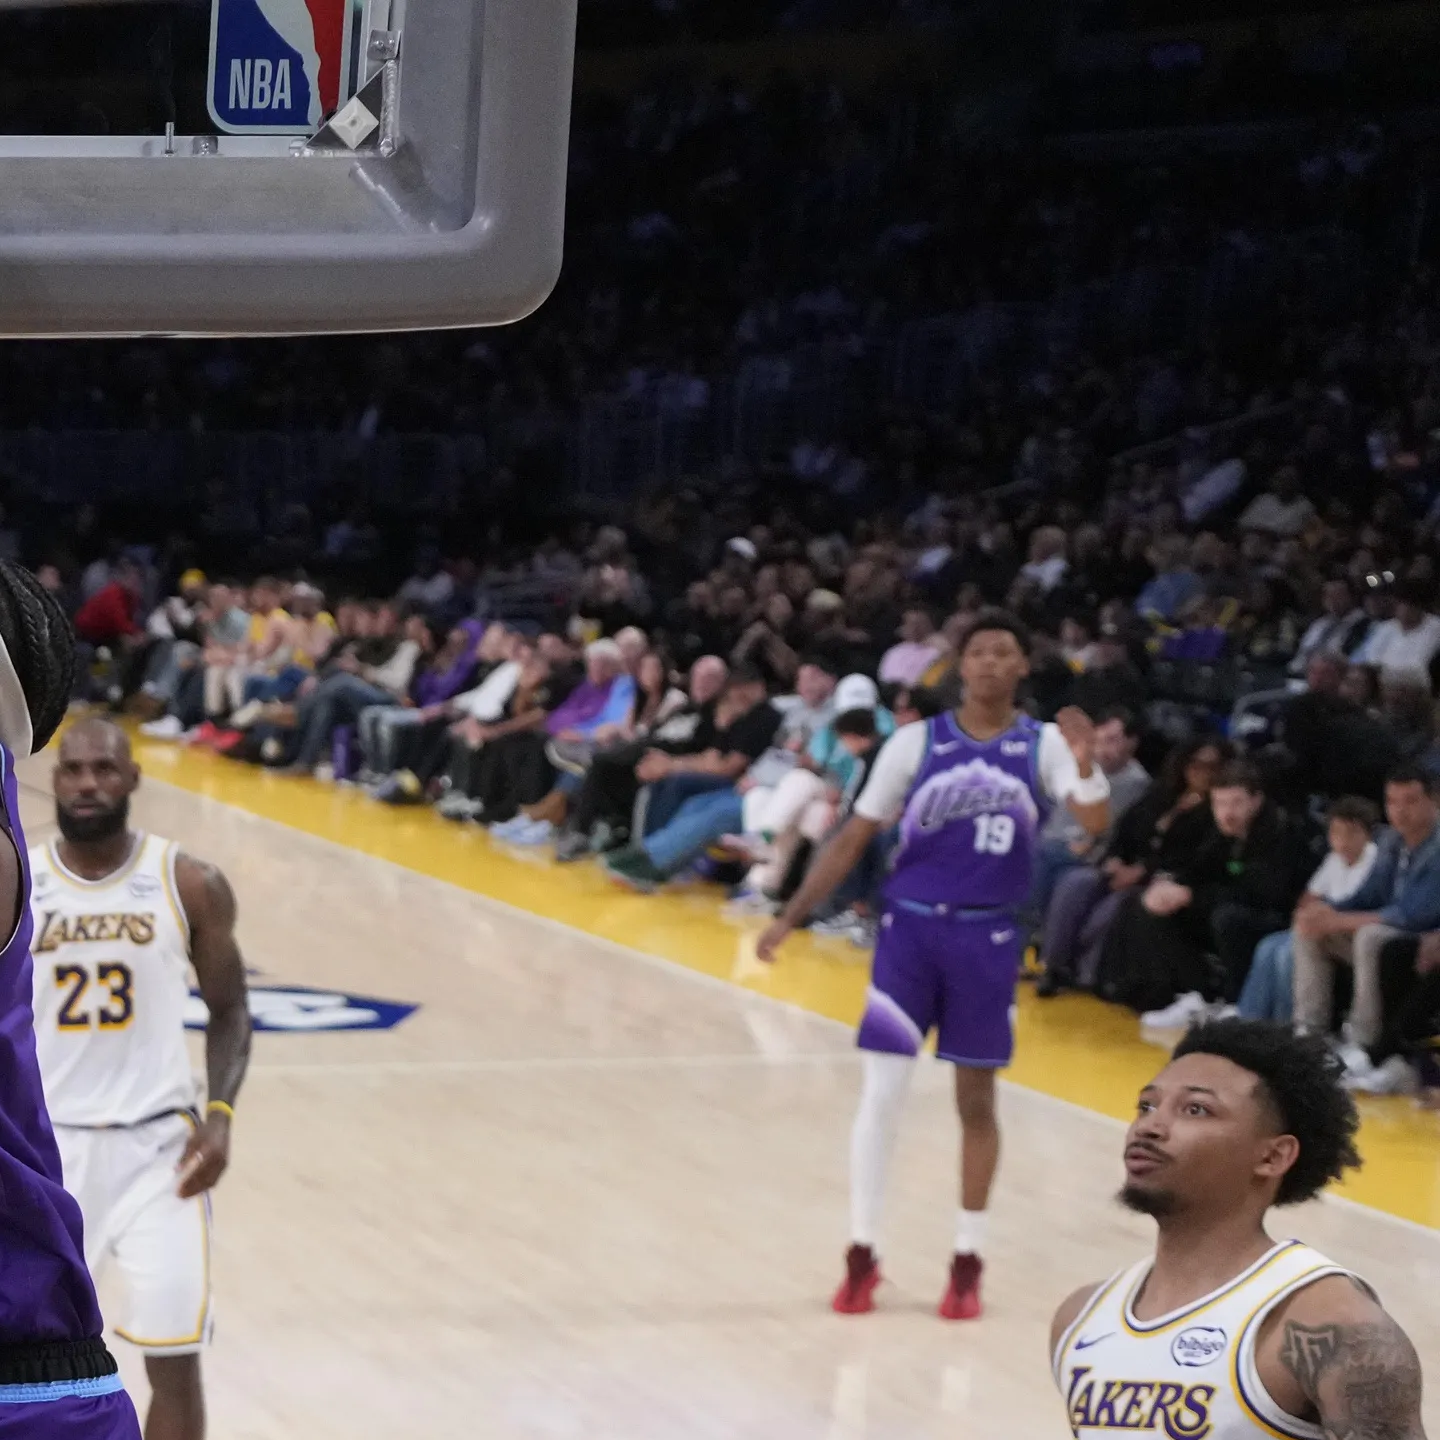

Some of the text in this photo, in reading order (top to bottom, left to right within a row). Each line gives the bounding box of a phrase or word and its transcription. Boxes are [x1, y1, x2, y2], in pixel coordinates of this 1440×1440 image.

[228, 58, 292, 109] NBA
[973, 812, 1016, 856] 19
[32, 910, 156, 955] LAKERS
[54, 962, 135, 1032] 23
